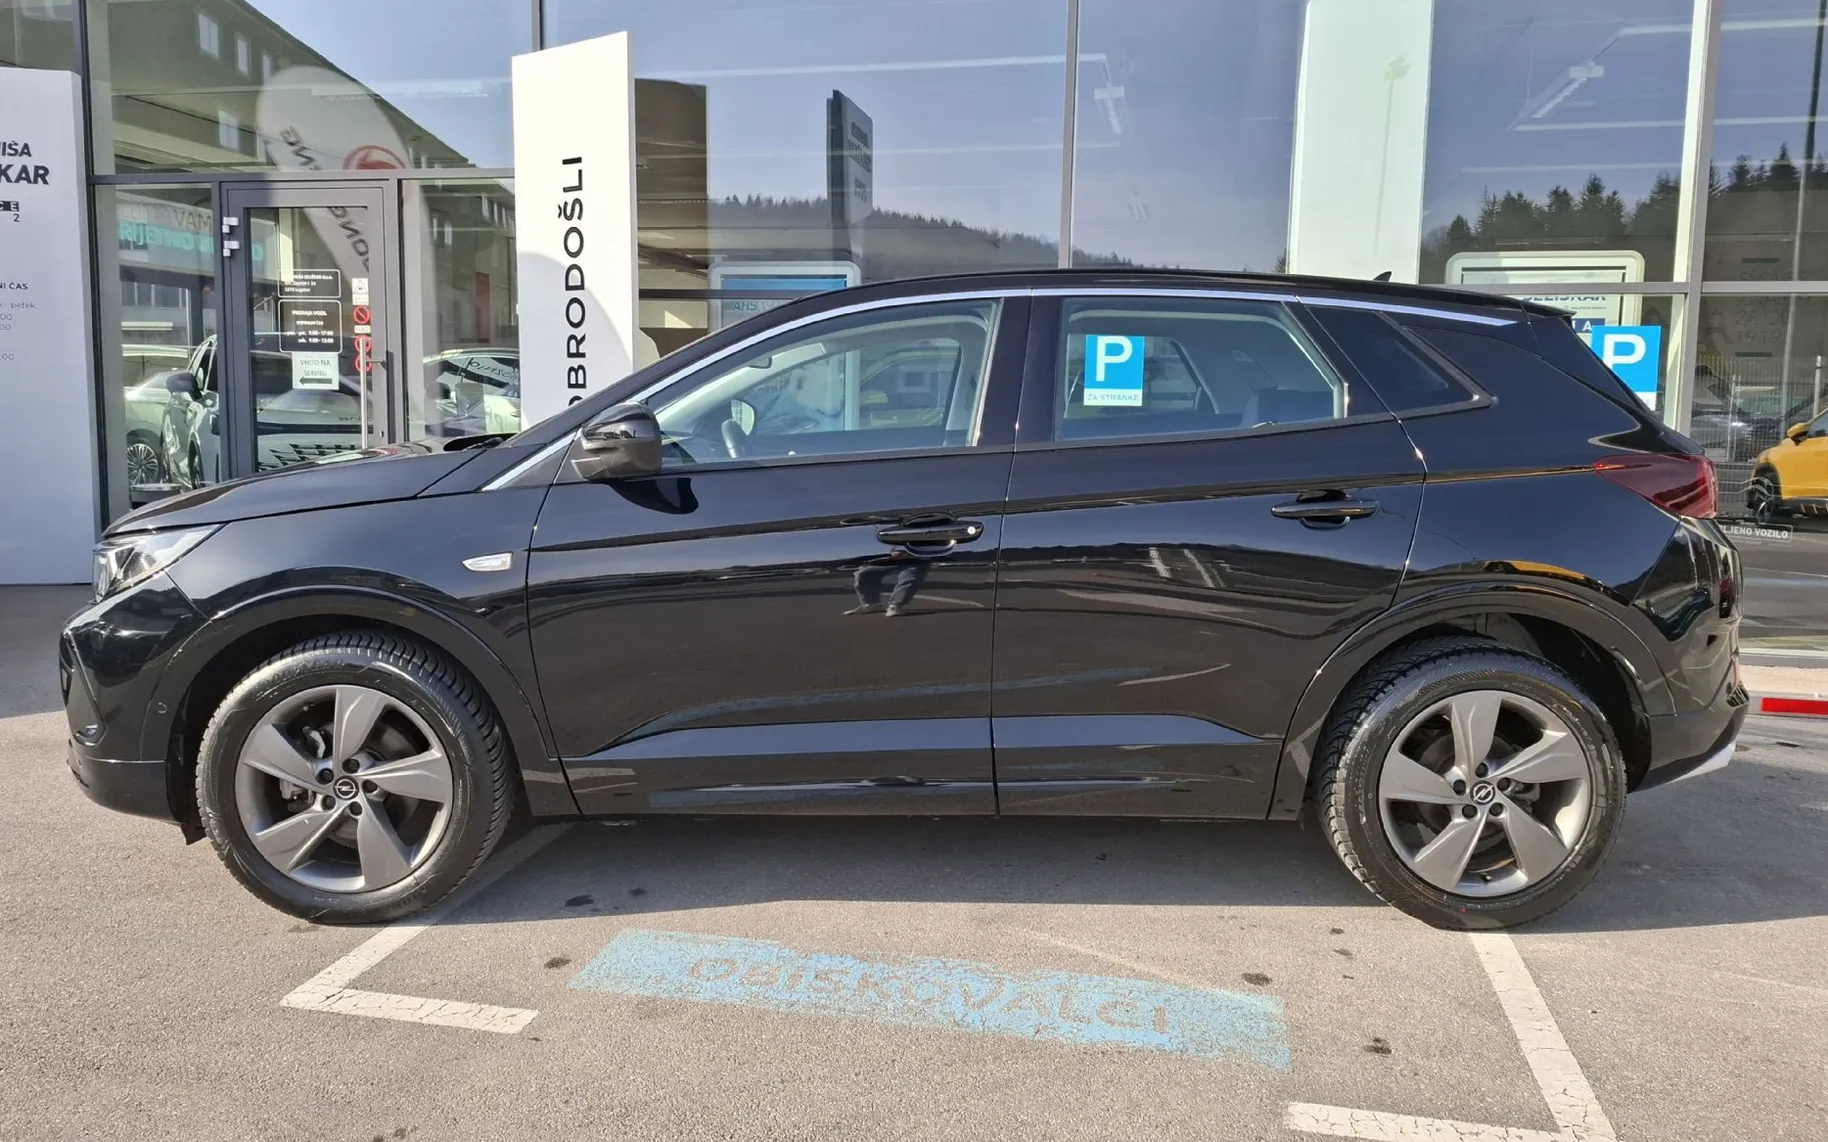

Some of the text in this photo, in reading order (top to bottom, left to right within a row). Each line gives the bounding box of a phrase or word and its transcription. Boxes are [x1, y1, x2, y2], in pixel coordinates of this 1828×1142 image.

[13, 213, 20, 222] 2
[8, 281, 28, 290] ČAS
[1096, 335, 1133, 382] P
[1754, 528, 1789, 539] VOZILO
